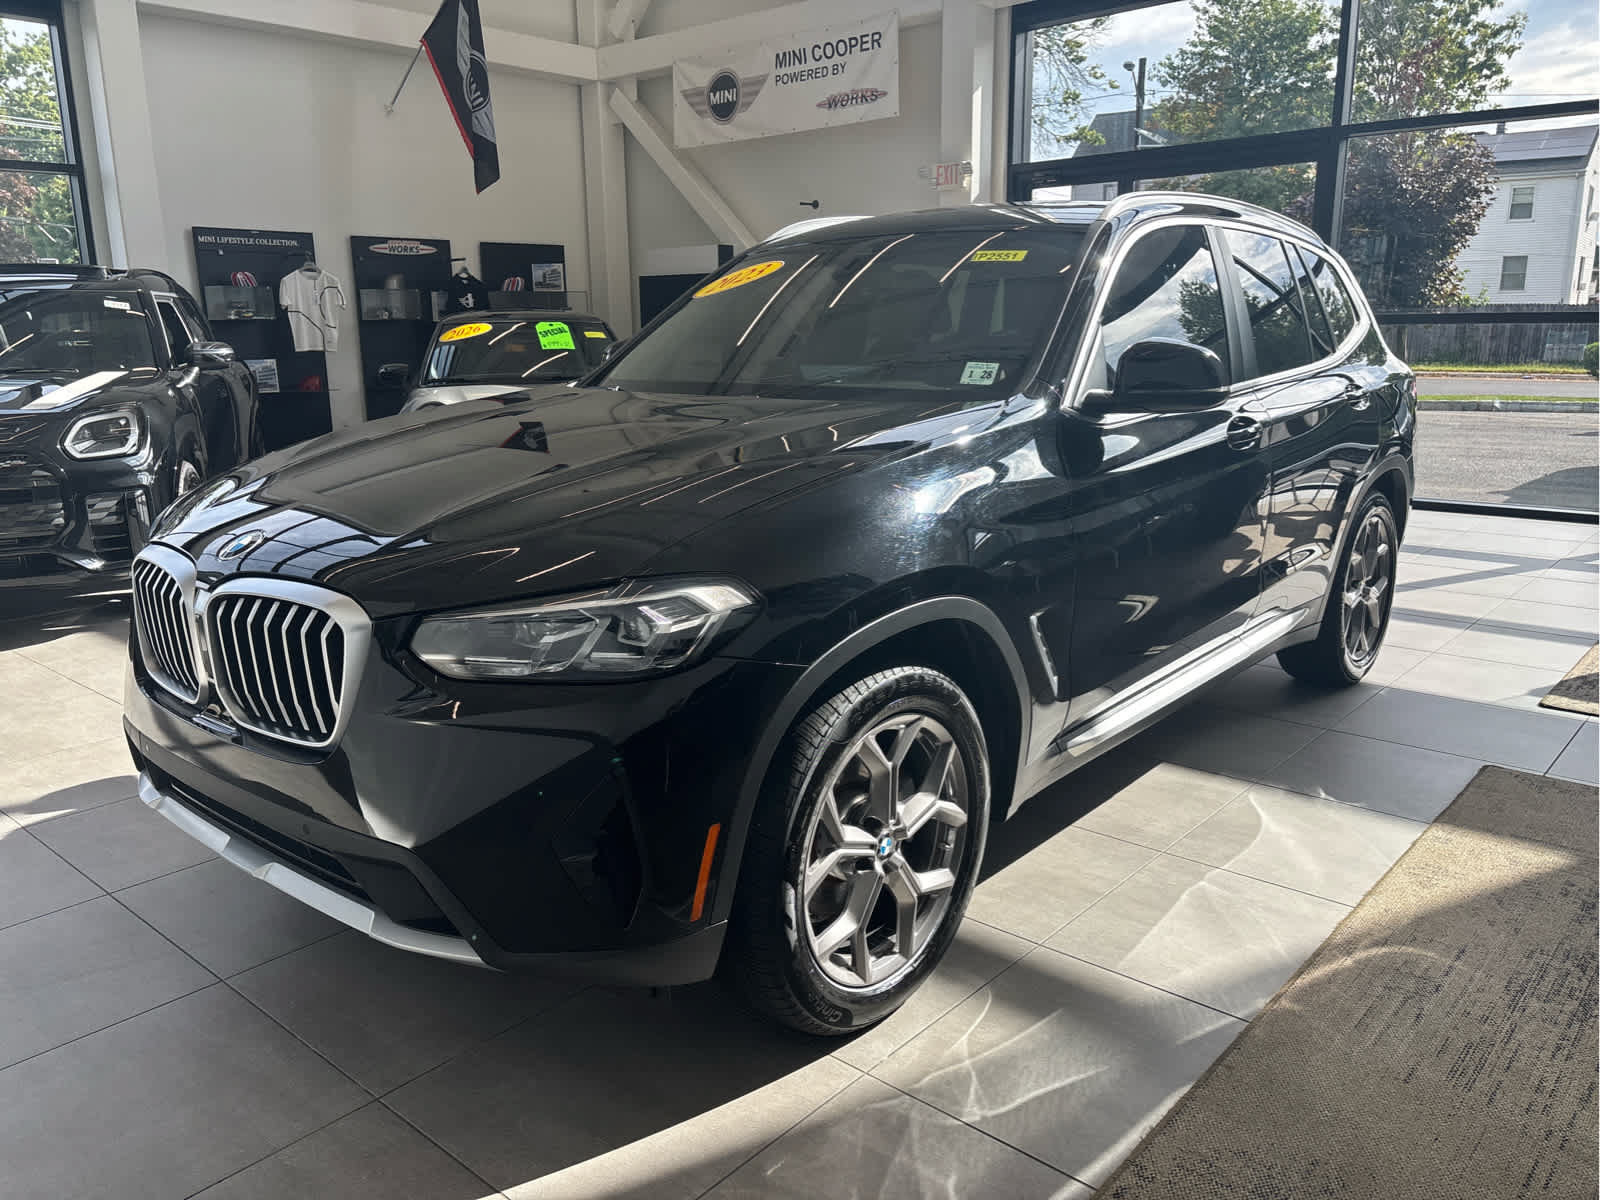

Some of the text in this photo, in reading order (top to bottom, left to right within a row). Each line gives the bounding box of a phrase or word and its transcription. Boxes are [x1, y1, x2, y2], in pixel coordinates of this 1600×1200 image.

[775, 31, 883, 70] MINI COOPER
[775, 61, 848, 87] POWERED BY
[709, 87, 737, 105] MINI
[827, 90, 879, 109] WORKS
[936, 163, 961, 187] EXIT
[197, 235, 216, 244] MINI
[388, 244, 421, 254] WORKS
[449, 325, 481, 340] 2026
[539, 326, 569, 338] SPECIAL
